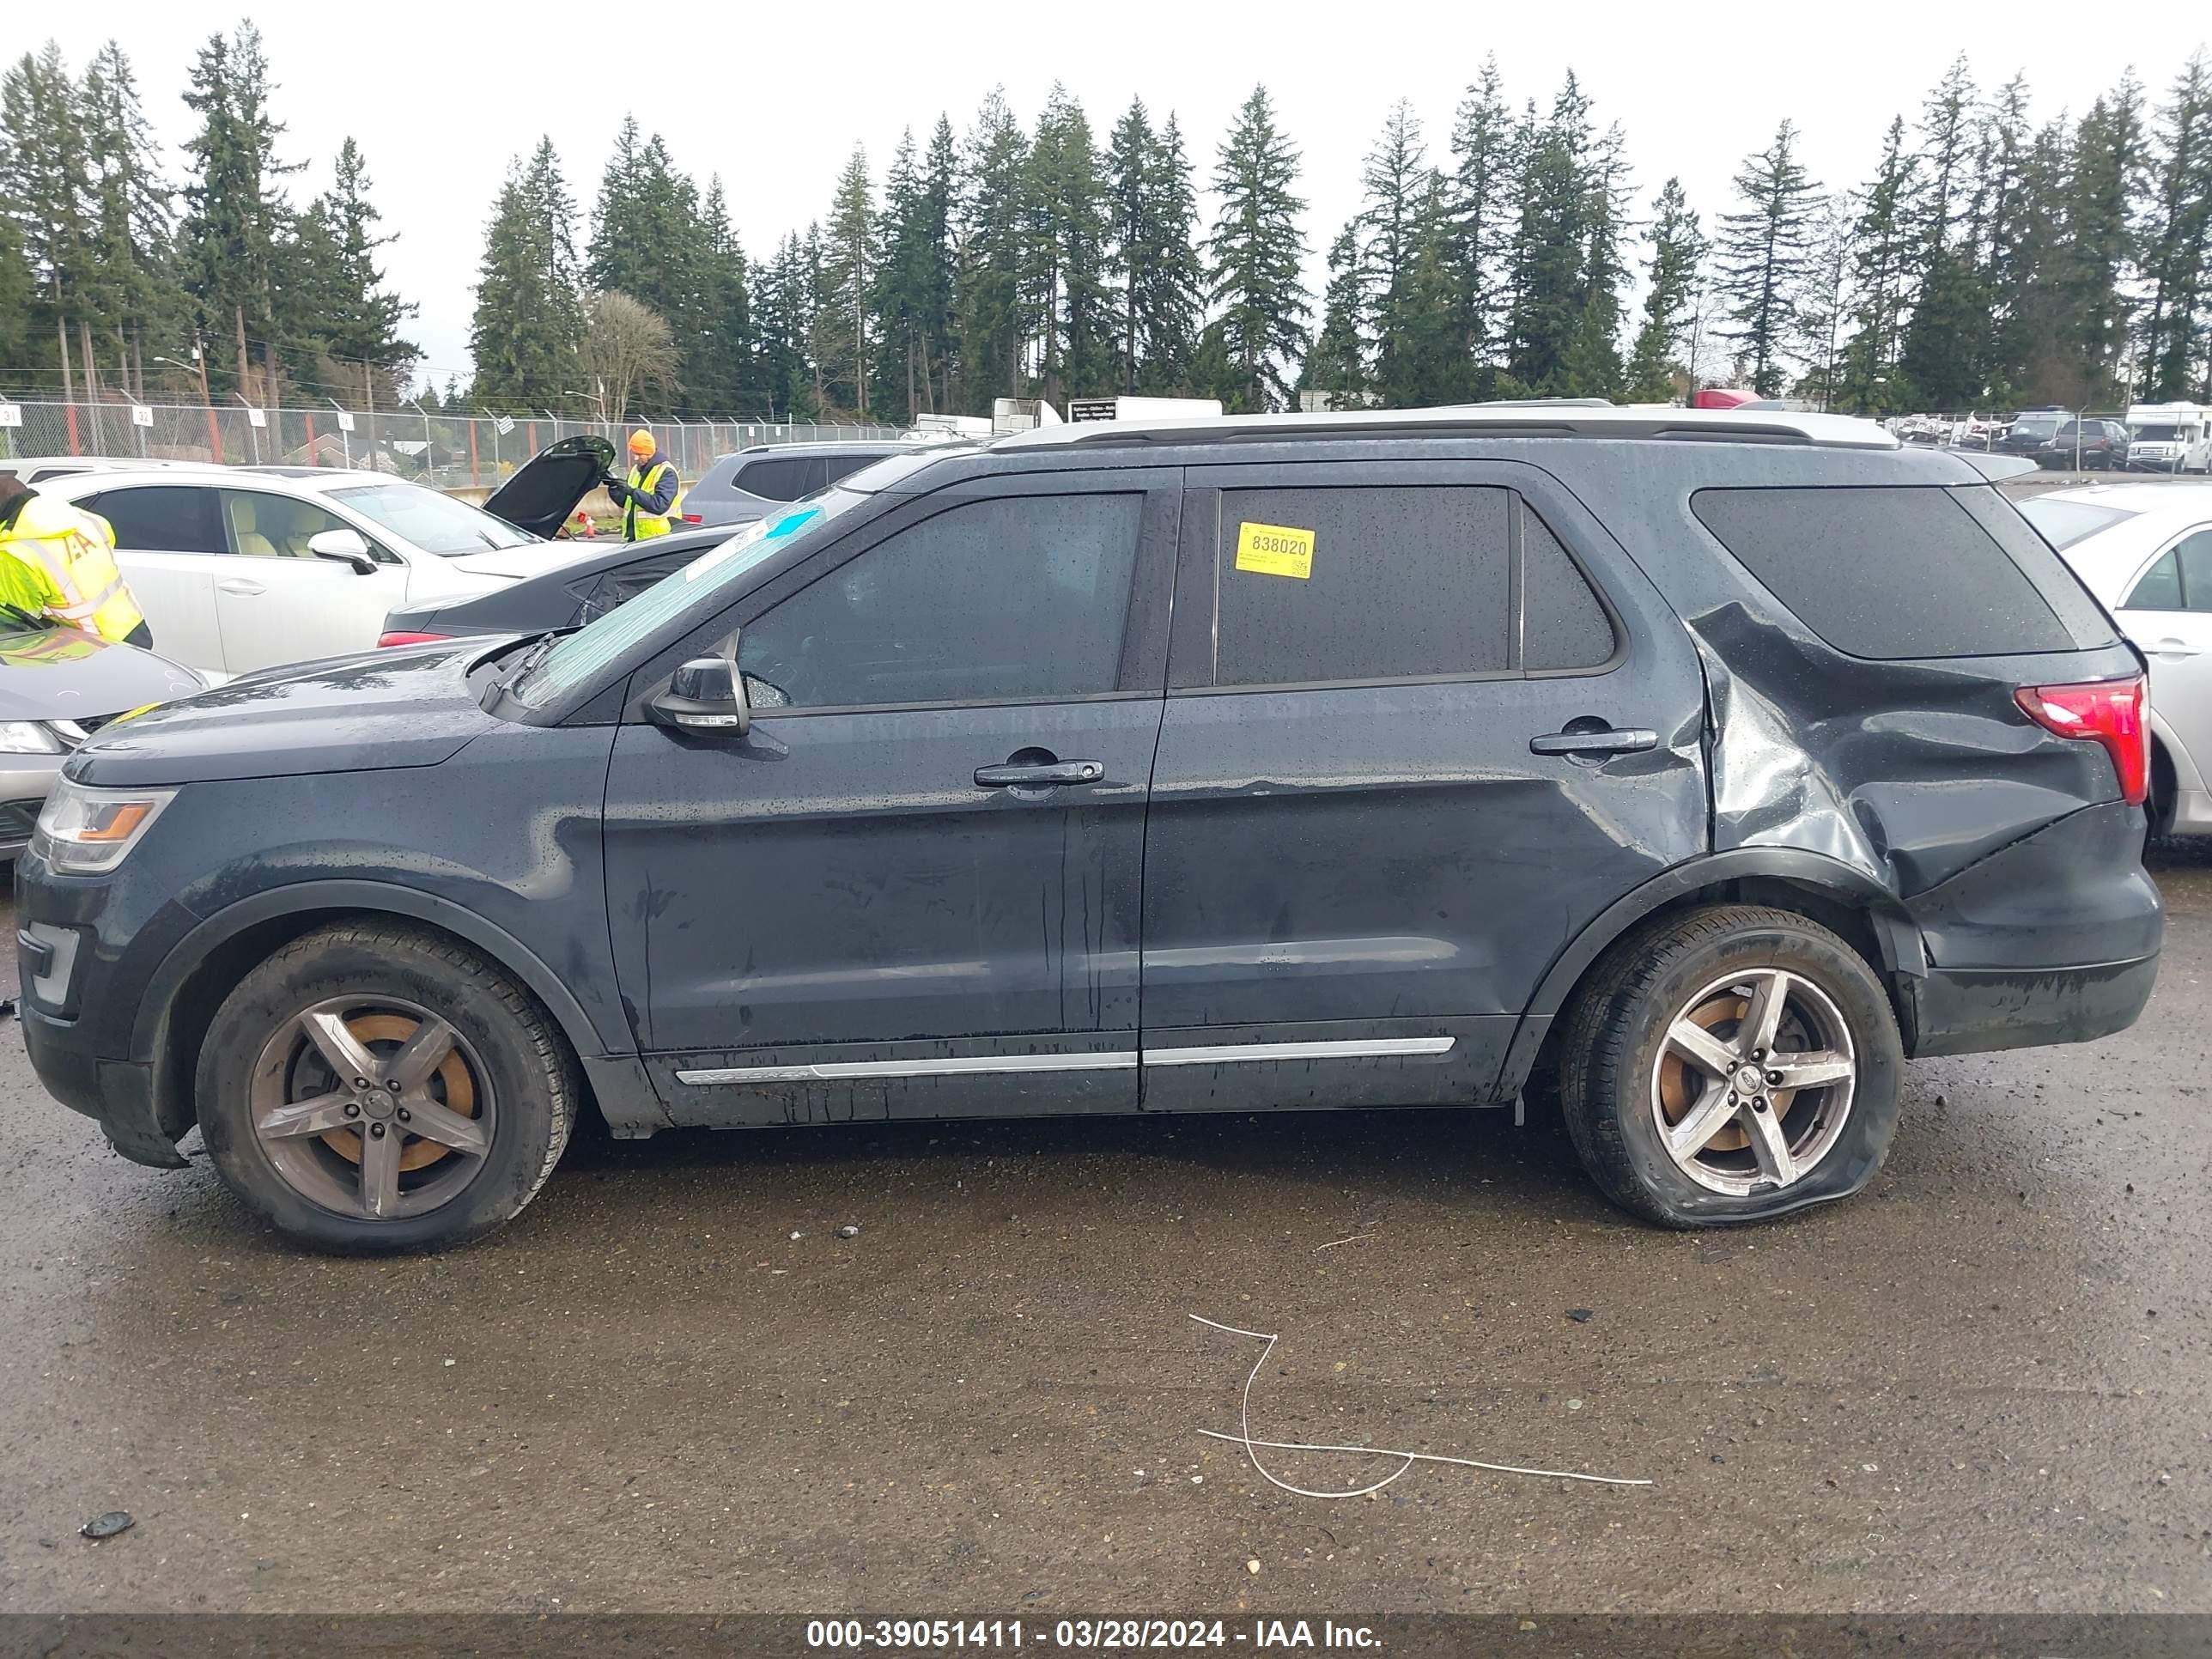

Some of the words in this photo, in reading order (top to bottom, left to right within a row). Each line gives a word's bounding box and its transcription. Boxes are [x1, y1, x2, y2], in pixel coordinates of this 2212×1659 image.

[3, 410, 15, 422] 31
[138, 411, 149, 422] 32
[1252, 535, 1307, 556] 838020
